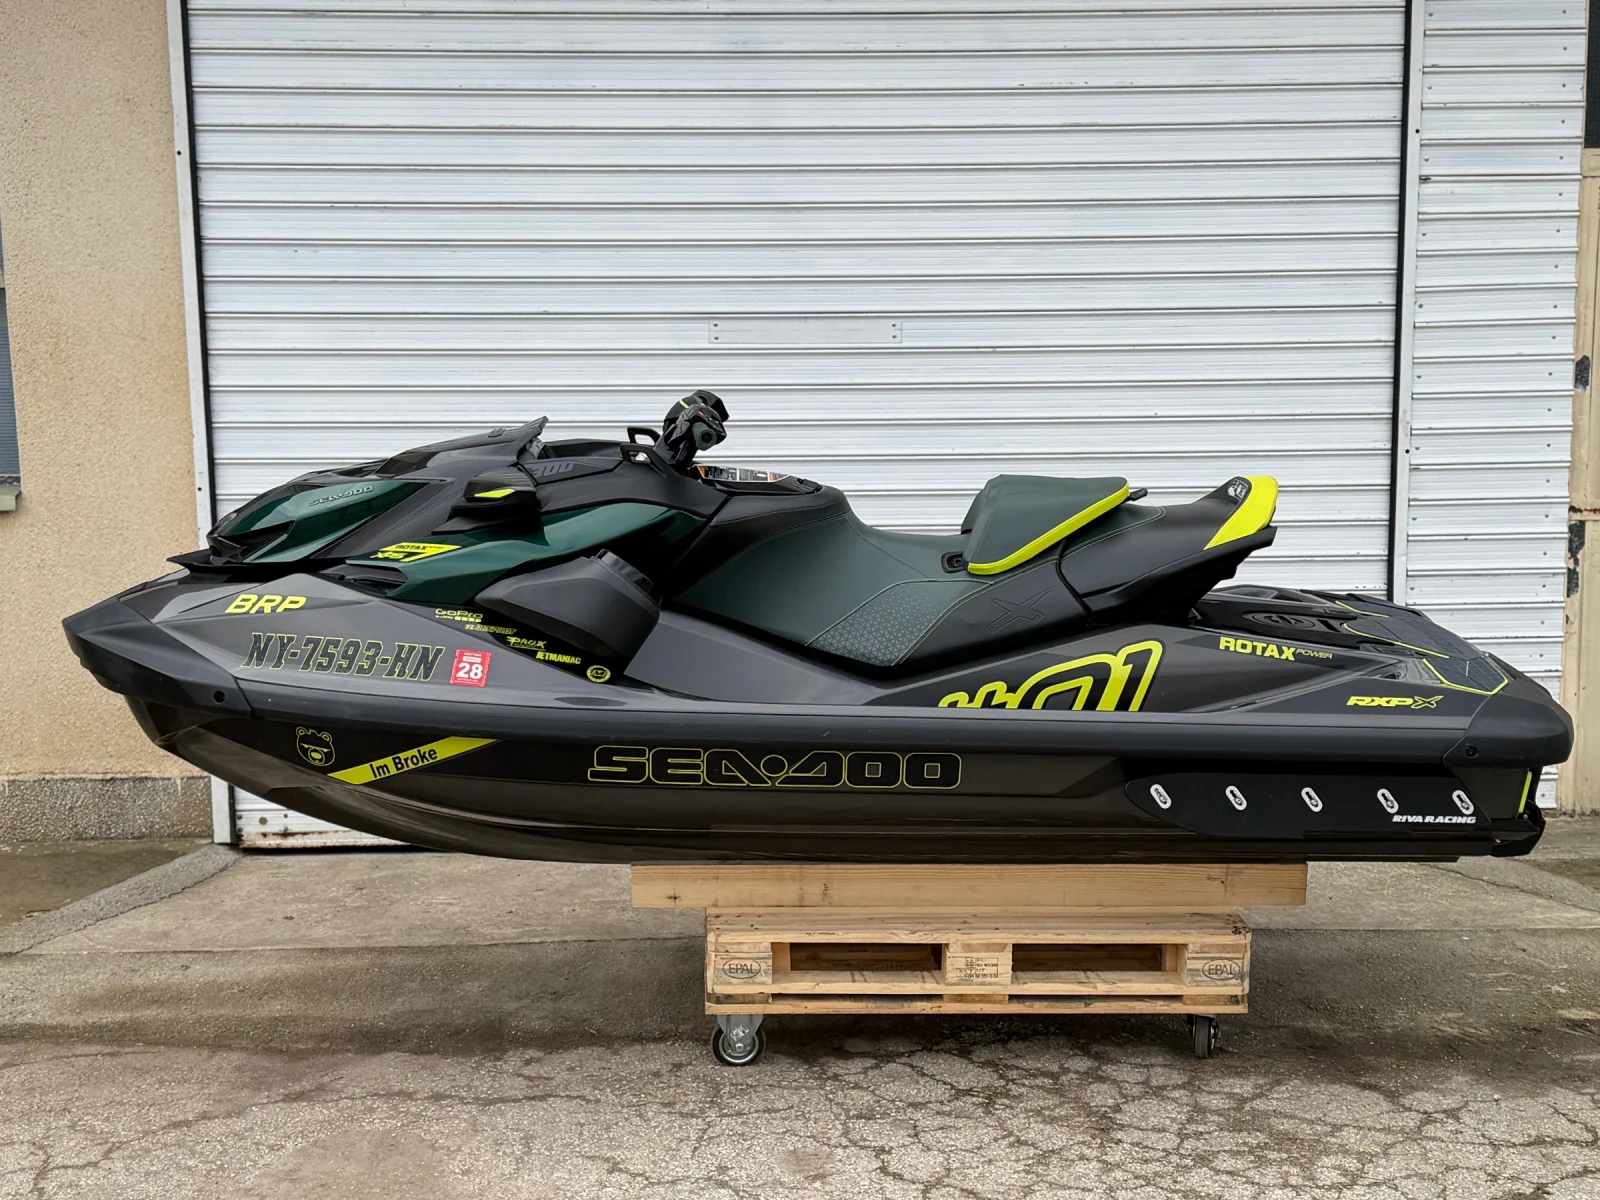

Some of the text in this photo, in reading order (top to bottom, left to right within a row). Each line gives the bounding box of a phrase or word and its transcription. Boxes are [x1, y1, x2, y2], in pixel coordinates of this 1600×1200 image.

[225, 594, 307, 614] BRP
[435, 608, 484, 619] GoPro
[240, 632, 446, 681] NY-7593-HN
[1219, 636, 1333, 661] ROTAX POWER
[456, 662, 483, 680] 28
[369, 748, 438, 778] Im Broke
[1392, 814, 1477, 824] RIVA RACING
[728, 963, 758, 974] EPAL
[1208, 964, 1235, 976] EPAL
